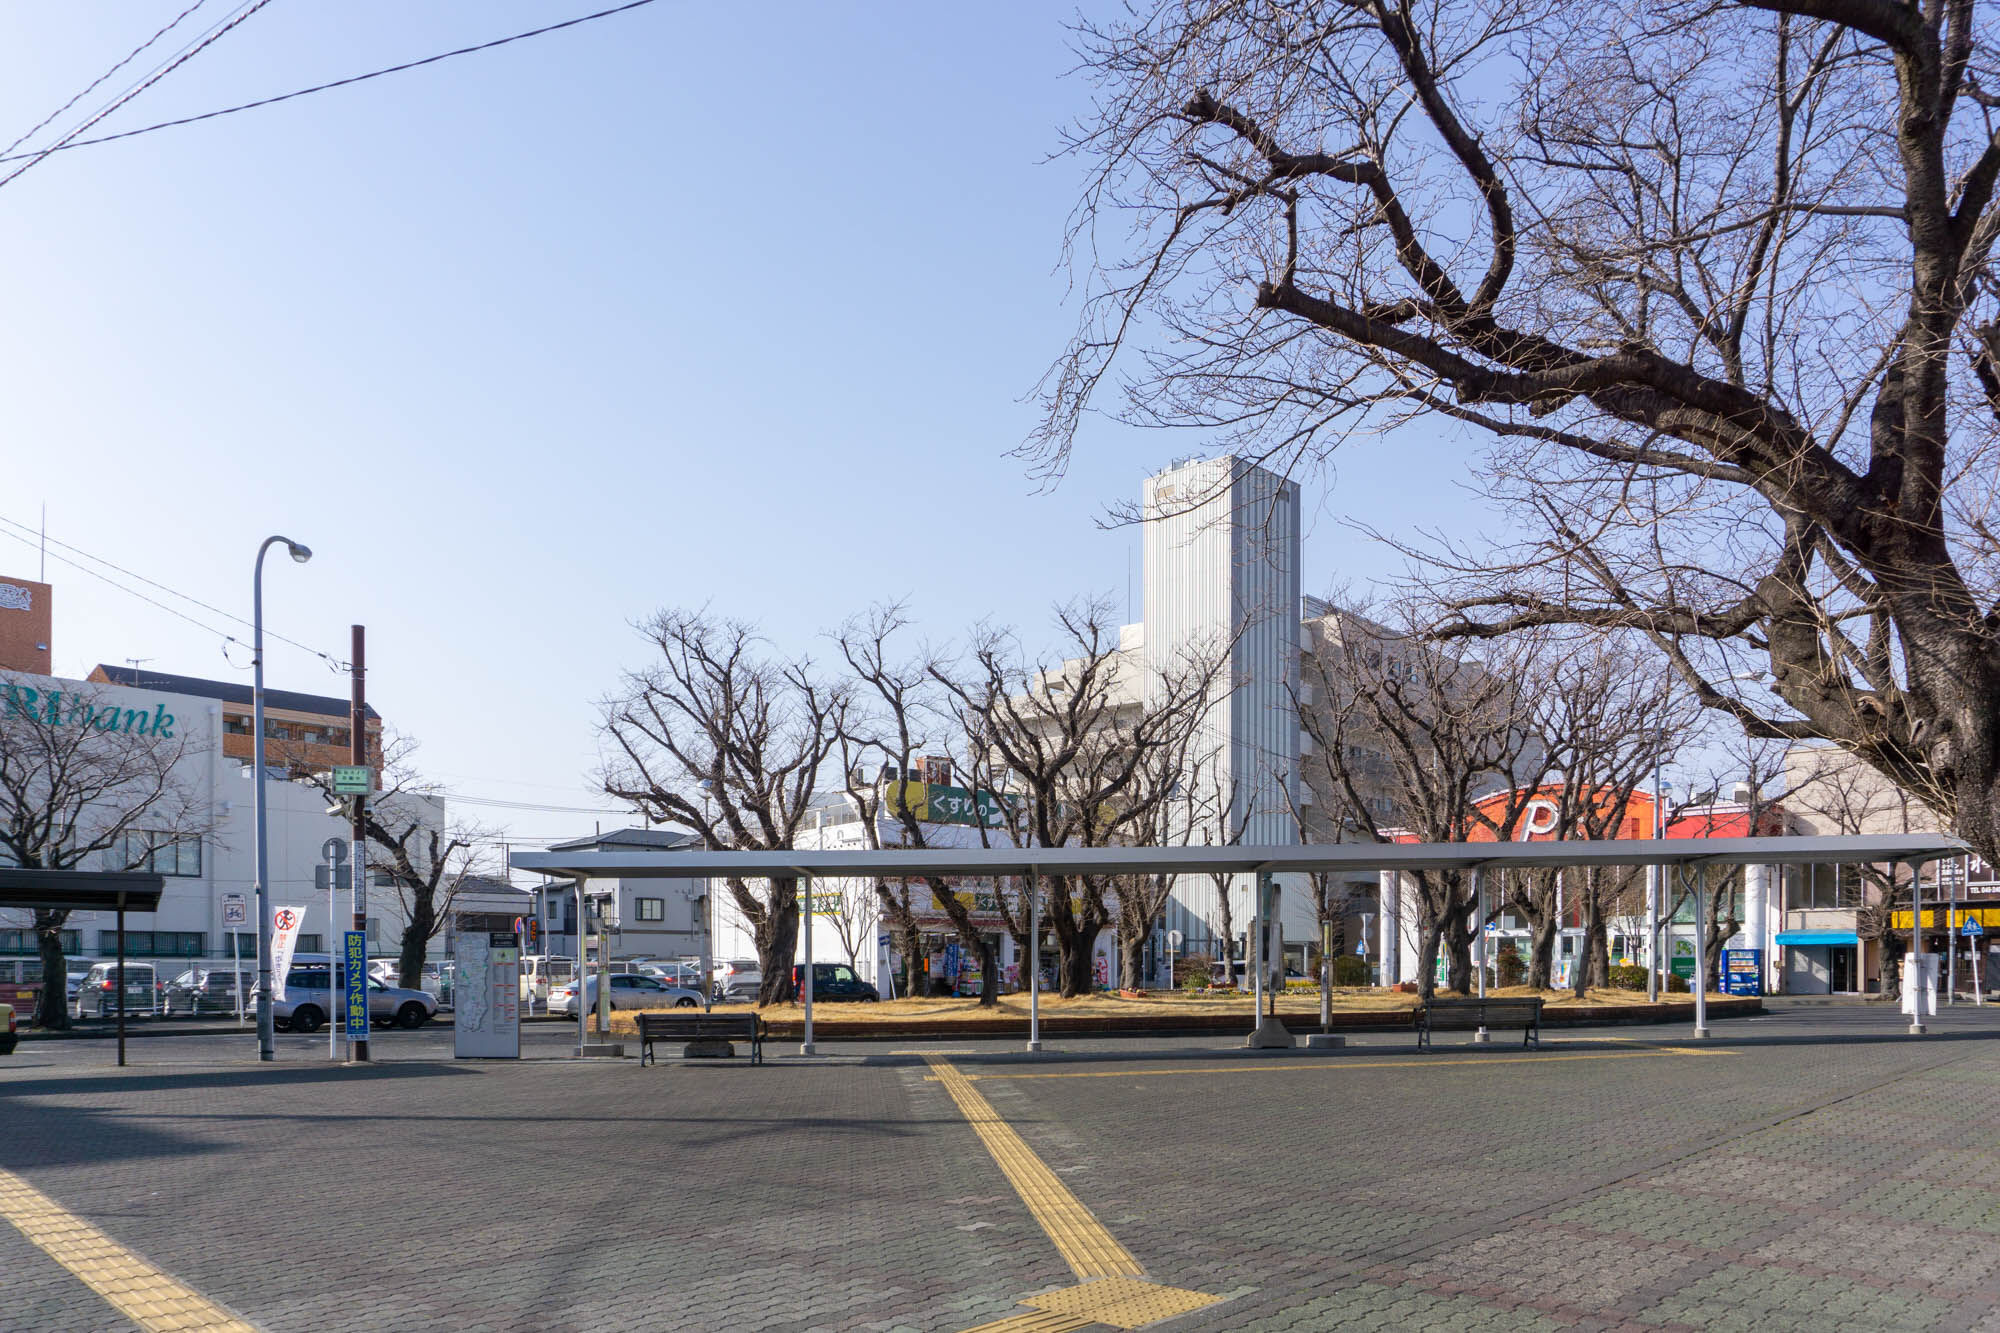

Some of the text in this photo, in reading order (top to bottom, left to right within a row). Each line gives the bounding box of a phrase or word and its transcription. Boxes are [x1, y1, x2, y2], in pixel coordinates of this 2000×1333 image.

[347, 934, 364, 1029] 防犯カメラ作動中
